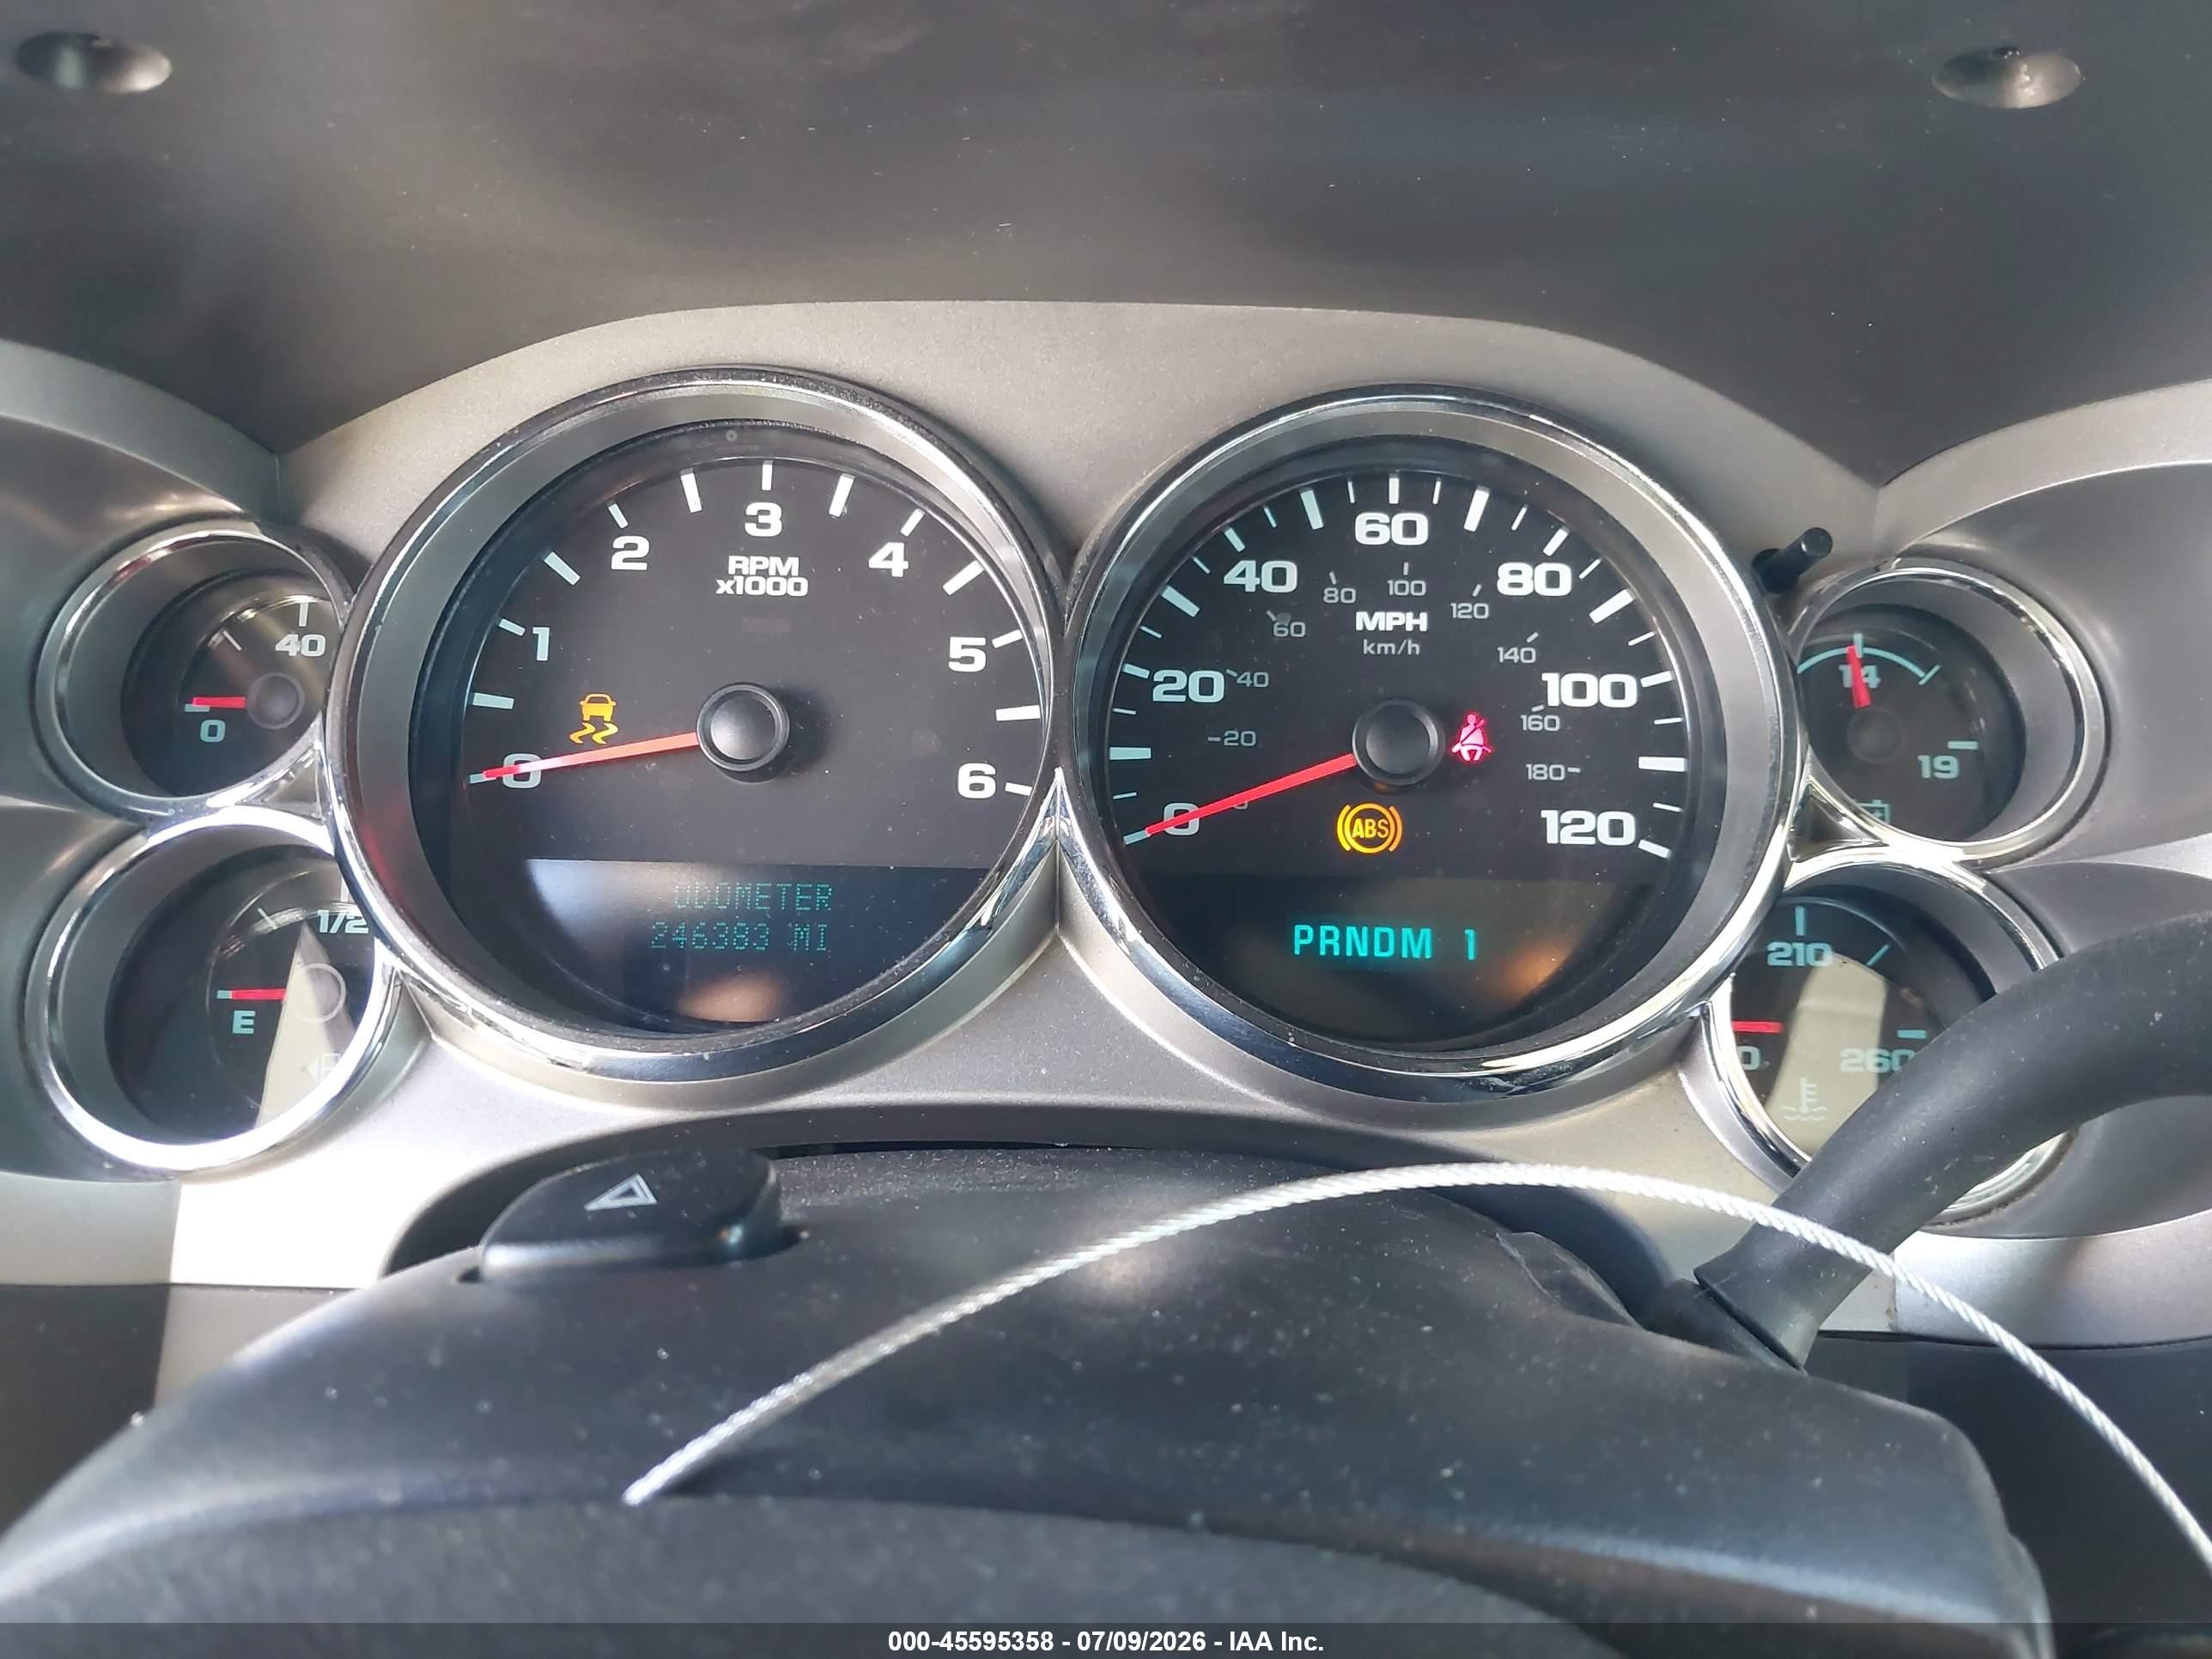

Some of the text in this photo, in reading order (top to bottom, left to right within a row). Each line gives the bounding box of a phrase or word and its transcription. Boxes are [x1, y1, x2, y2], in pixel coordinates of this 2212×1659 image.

[744, 501, 783, 538] 3
[1354, 513, 1429, 547] 60
[611, 535, 651, 571] 2
[727, 555, 800, 576] RPM
[868, 542, 909, 577] 4
[715, 574, 809, 598] x1000
[1223, 559, 1298, 593] 40
[1387, 580, 1427, 598] 100
[1497, 562, 1572, 598] 80
[1322, 586, 1357, 605] 80
[1355, 611, 1429, 633] MPH
[1450, 602, 1490, 621] 120
[1273, 620, 1306, 639] 60
[275, 634, 327, 658] 40
[531, 626, 550, 662] 1
[948, 636, 988, 672] 5
[1363, 637, 1421, 657] km/h
[1497, 647, 1536, 665] 140
[1152, 669, 1225, 703] 20
[1235, 670, 1270, 689] 40
[1540, 672, 1638, 708] 100
[198, 719, 227, 744] 0
[1521, 714, 1560, 733] 160
[1223, 730, 1257, 748] 20
[501, 753, 543, 790] 0
[1525, 763, 1565, 781] 180
[1917, 755, 1960, 780] 19
[957, 763, 997, 799] 6
[1164, 802, 1200, 836] 0
[1351, 817, 1390, 841] ABS
[1540, 810, 1636, 846] 120
[673, 881, 835, 913] ODOMETER
[316, 908, 369, 934] 1/2
[649, 921, 830, 952] 246383 MI
[1292, 923, 1478, 961] PRNDM 1
[1766, 942, 1832, 968] 210
[232, 1010, 256, 1035] E
